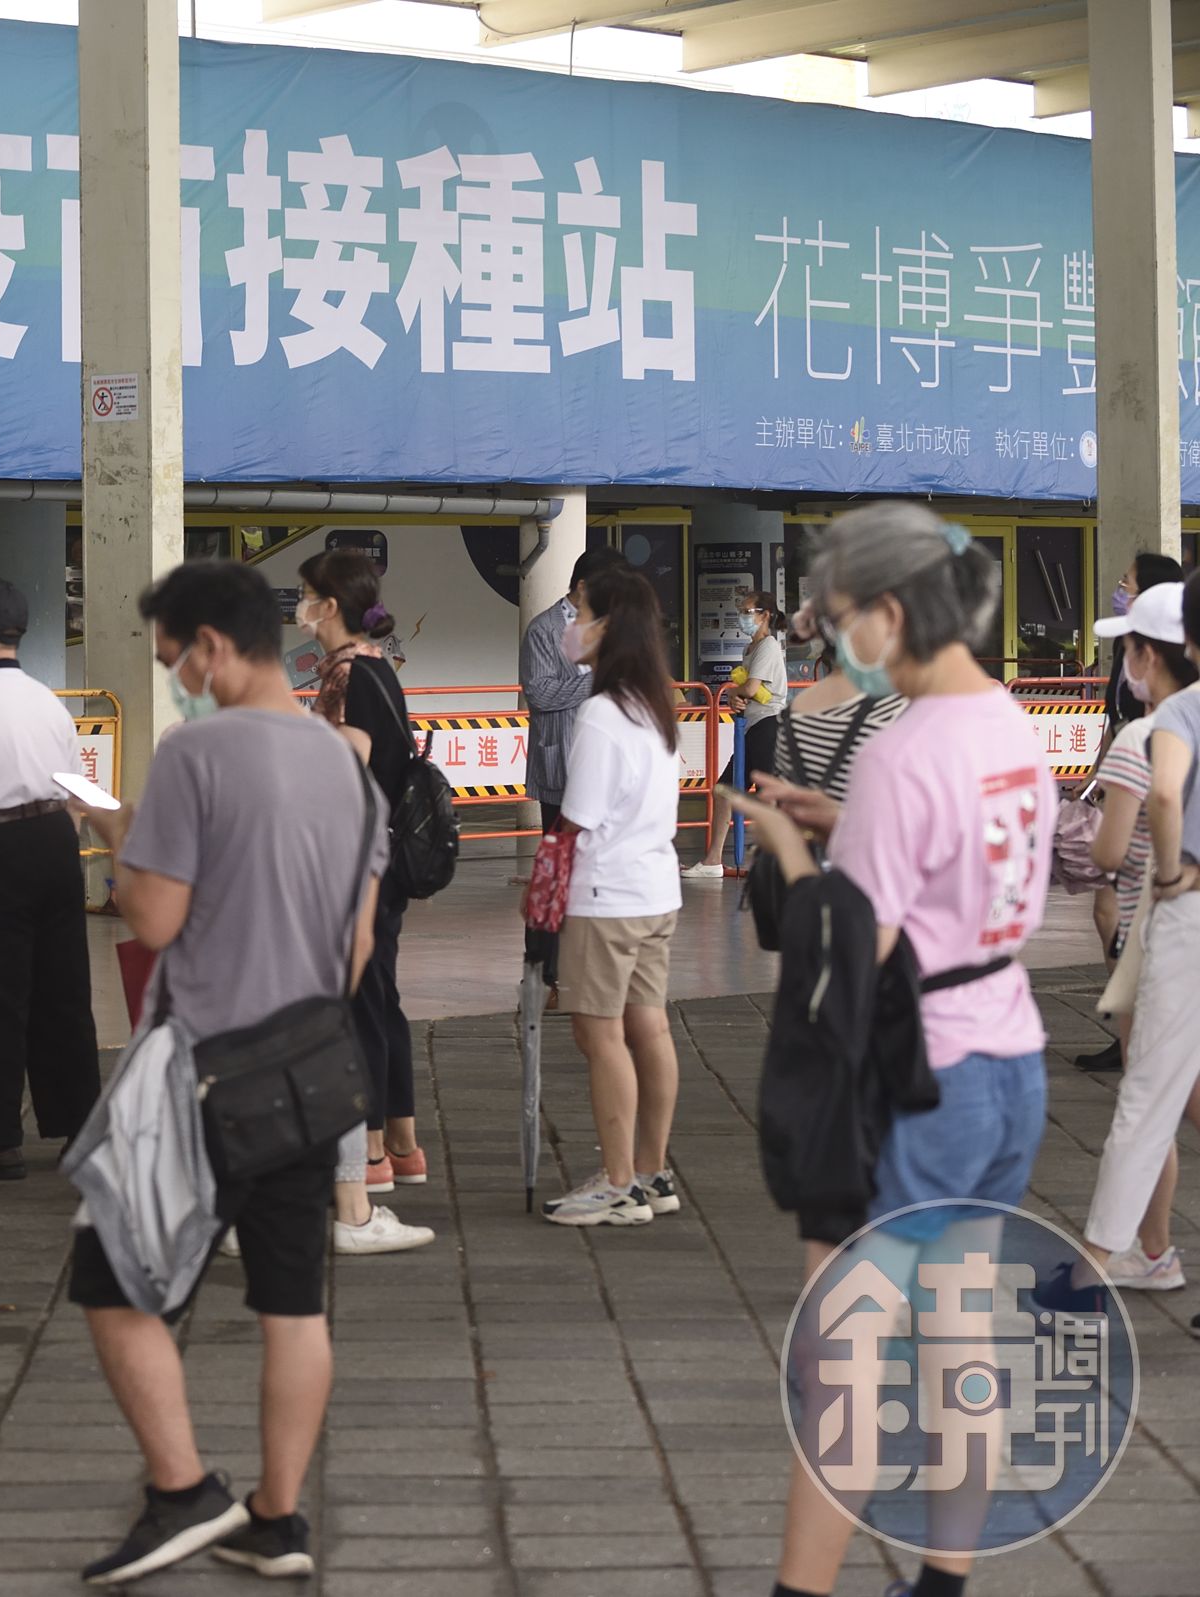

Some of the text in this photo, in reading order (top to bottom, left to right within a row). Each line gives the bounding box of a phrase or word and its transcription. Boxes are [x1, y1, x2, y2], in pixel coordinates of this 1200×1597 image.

[876, 422, 971, 457] 臺北市政府
